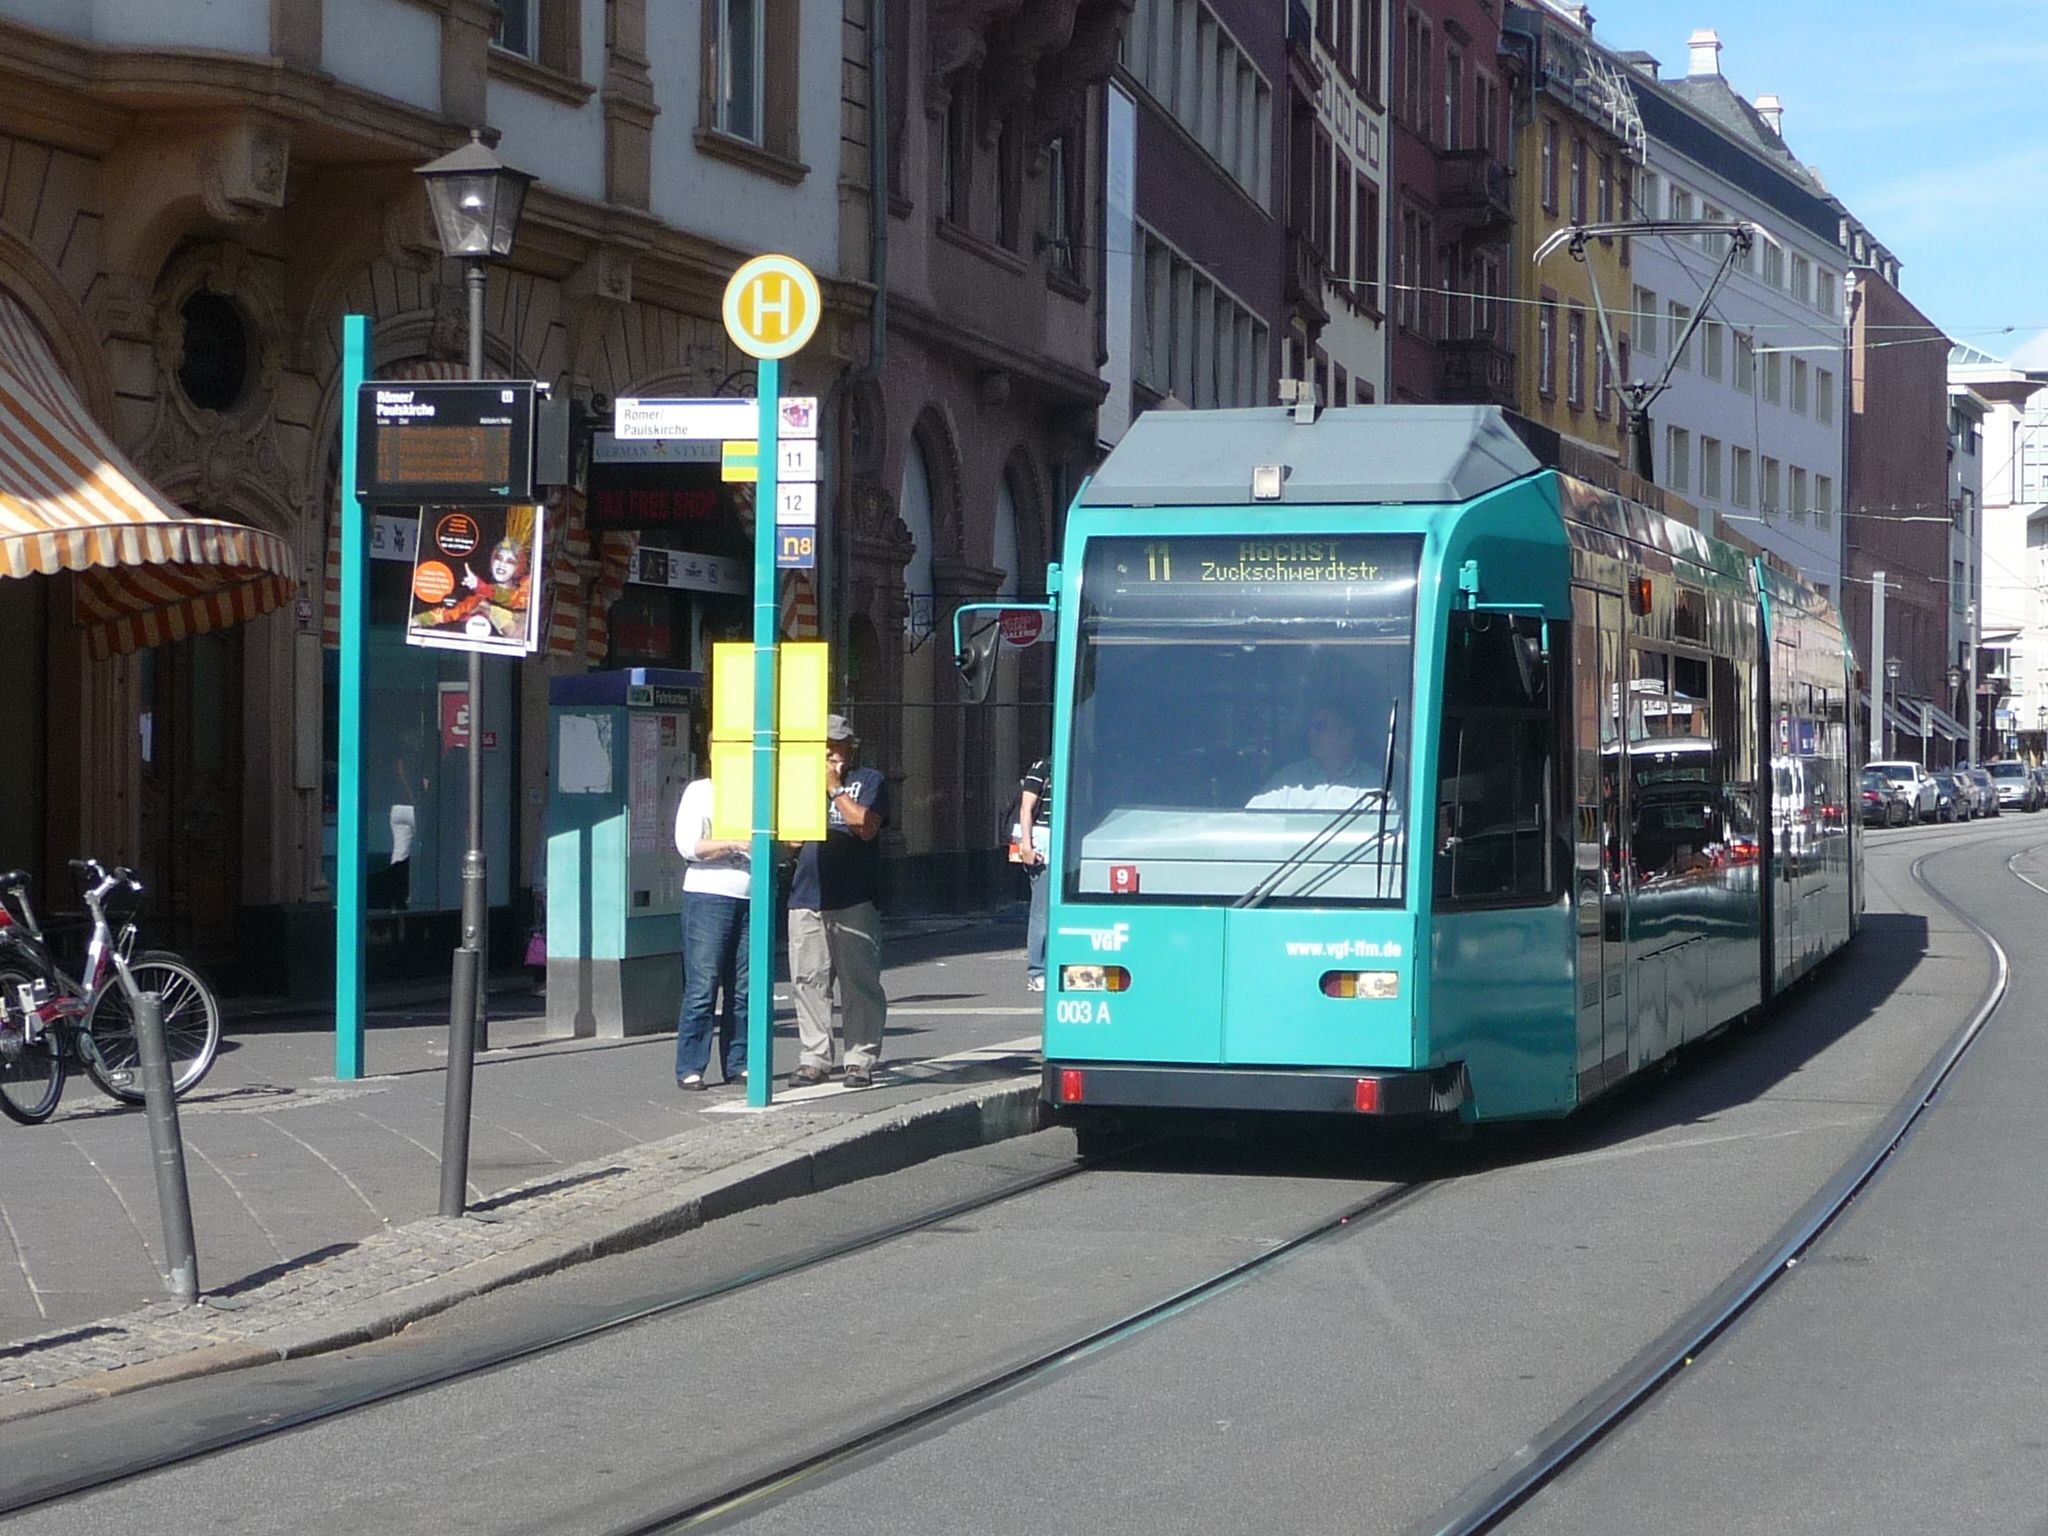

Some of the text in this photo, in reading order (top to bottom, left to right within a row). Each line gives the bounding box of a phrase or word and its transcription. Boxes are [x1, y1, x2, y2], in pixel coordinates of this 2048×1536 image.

[752, 279, 791, 336] H
[375, 403, 436, 416] Paulskirche
[623, 423, 689, 436] Paulskirche
[785, 451, 802, 468] 11
[785, 494, 802, 511] 12
[784, 536, 812, 555] n8
[1144, 542, 1172, 582] 11
[1116, 868, 1129, 886] 9
[1285, 940, 1403, 960] www.vgf-ffm.de
[1056, 1001, 1111, 1025] 003 A
